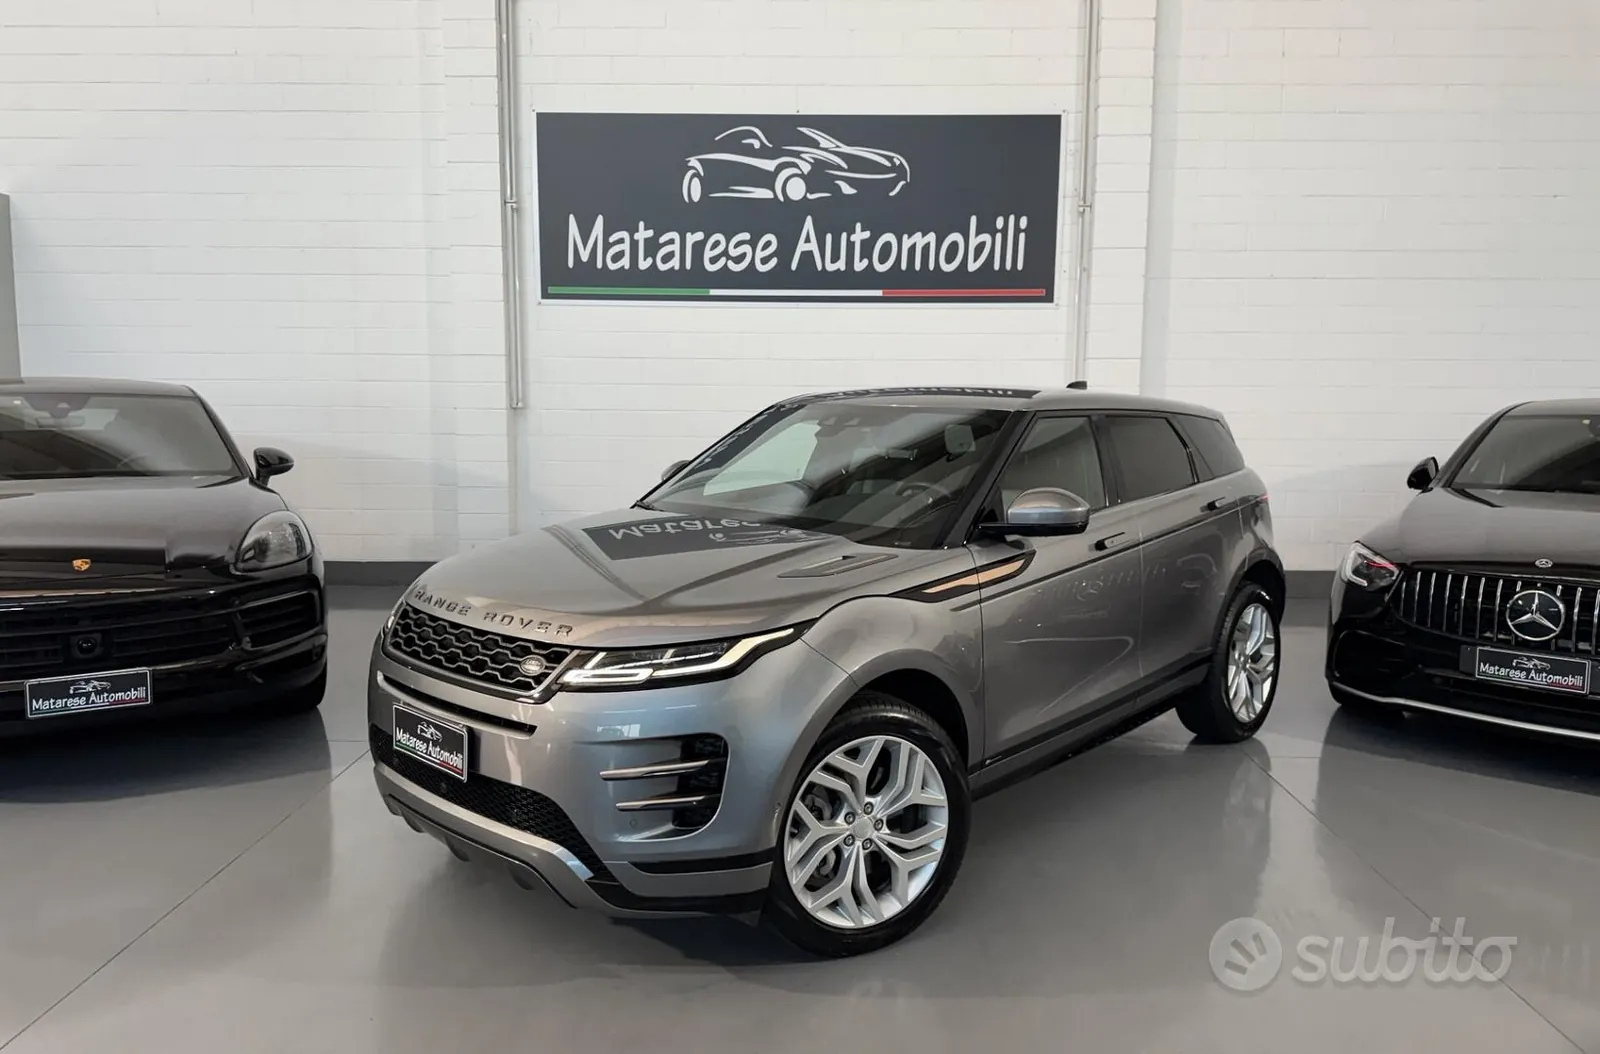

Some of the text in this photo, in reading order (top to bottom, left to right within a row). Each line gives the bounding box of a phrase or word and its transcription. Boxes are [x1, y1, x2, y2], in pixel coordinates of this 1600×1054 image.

[567, 214, 1028, 272] Matarese Automobili
[415, 590, 573, 637] RANGE ROVER
[1480, 662, 1583, 687] Matarese Automobili
[32, 686, 146, 711] Matarese Automobili
[395, 727, 463, 770] Matarese Automobili
